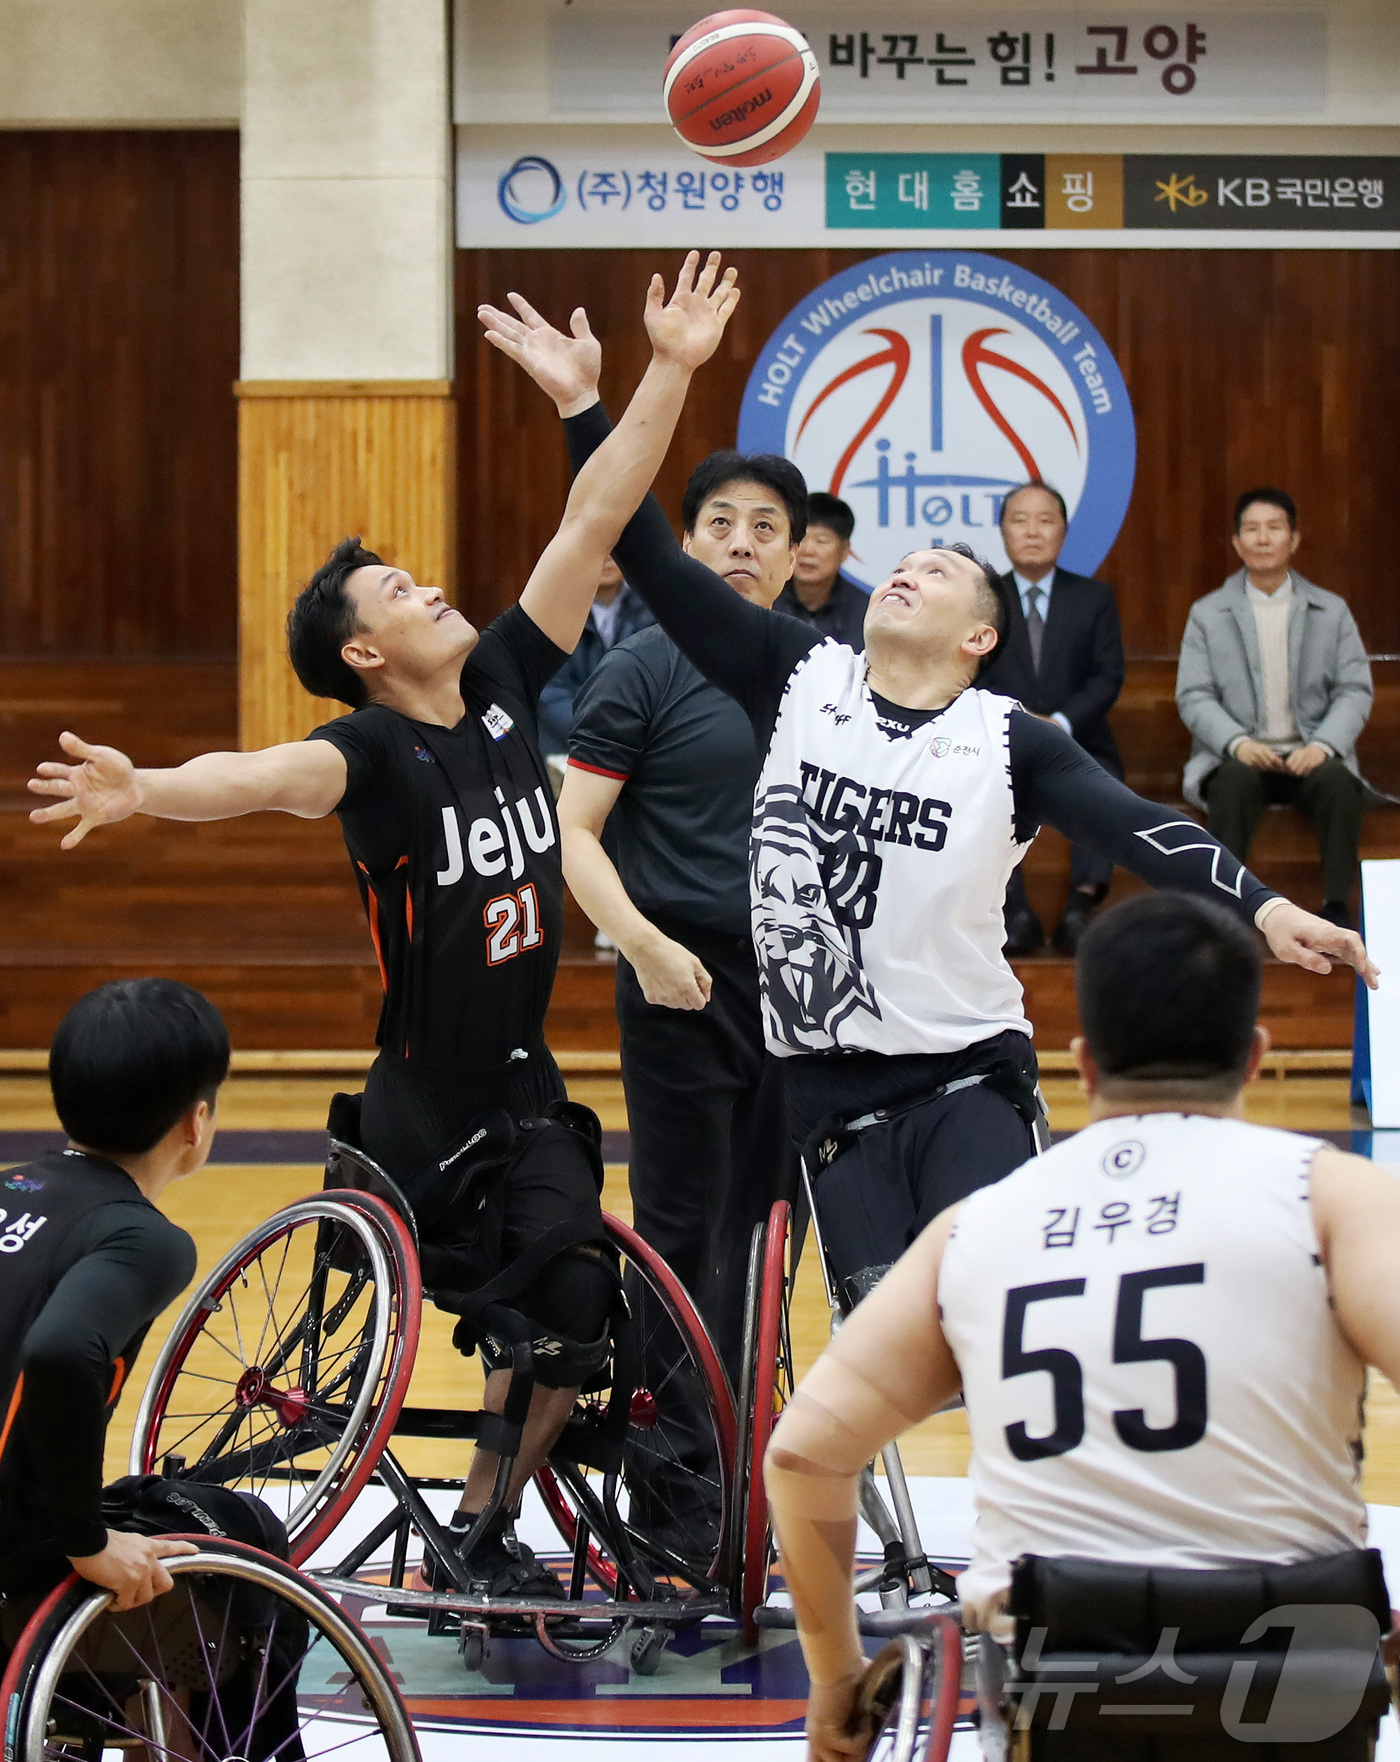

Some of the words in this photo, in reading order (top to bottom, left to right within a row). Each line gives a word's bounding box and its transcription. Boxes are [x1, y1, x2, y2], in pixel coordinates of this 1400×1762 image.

[829, 33, 976, 85] 바꾸는
[988, 32, 1055, 86] 힘!
[1075, 22, 1207, 95] 고양
[709, 87, 774, 132] molten
[577, 170, 785, 212] (주)청원양행
[757, 333, 807, 407] HOLT
[801, 263, 944, 336] Wheelchair
[953, 264, 1080, 345] Basketball
[1072, 342, 1112, 415] Team
[437, 785, 556, 886] Jeju
[799, 760, 952, 852] TIGERS
[483, 883, 544, 967] 21
[0, 1208, 48, 1253] 성
[1041, 1191, 1181, 1250] 김우경
[1001, 1262, 1207, 1463] 55
